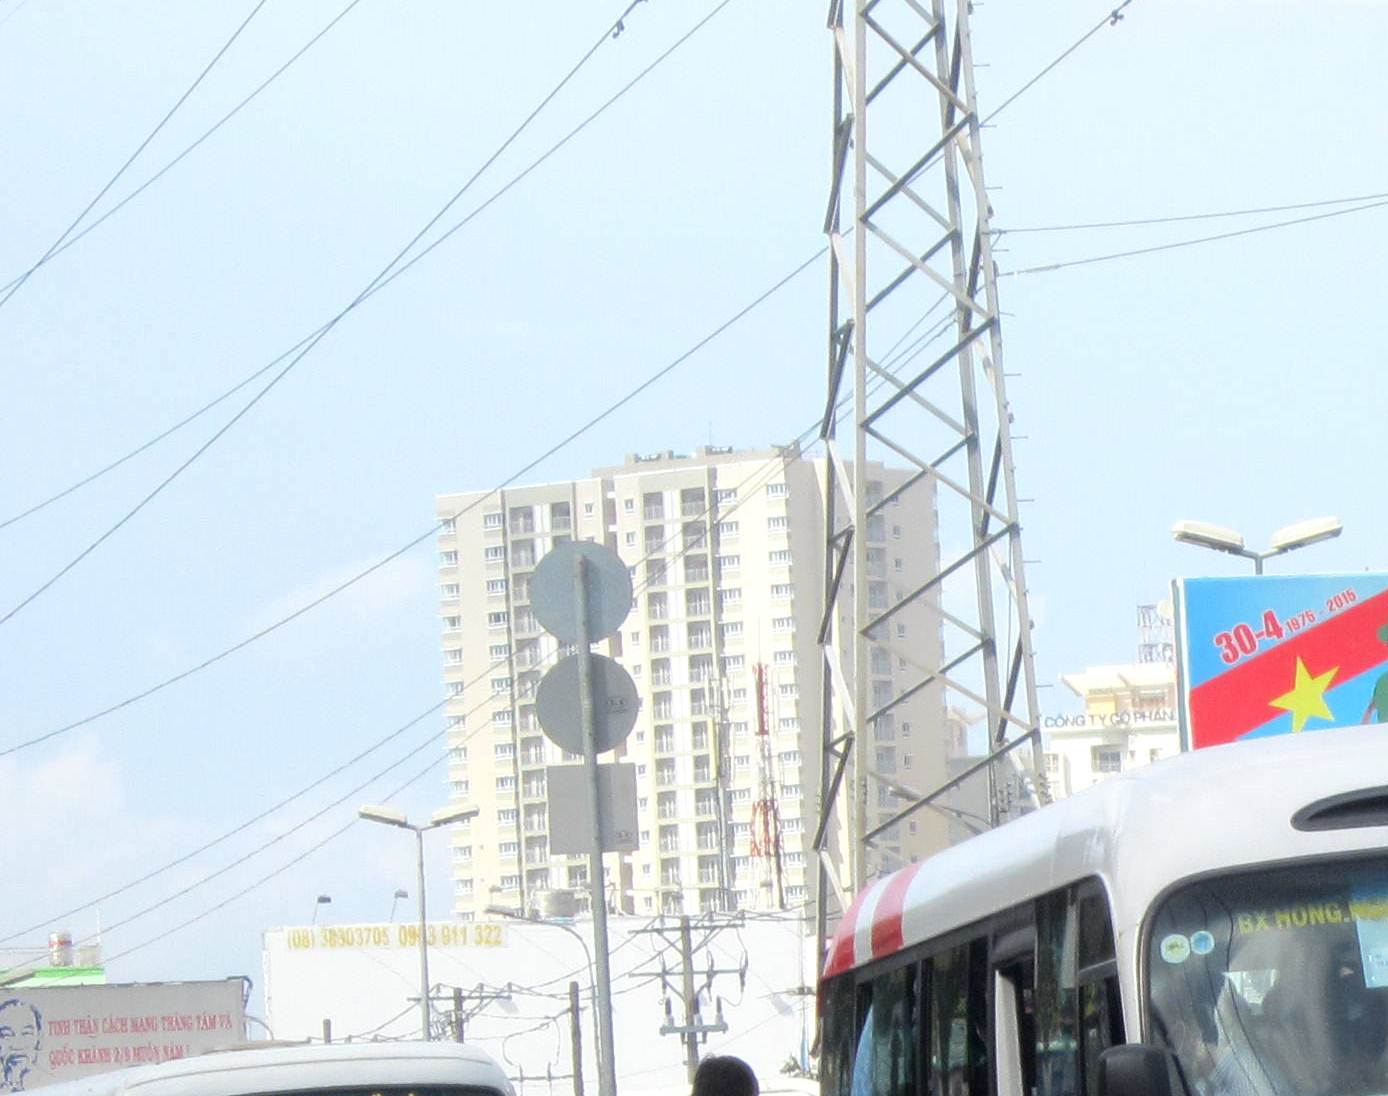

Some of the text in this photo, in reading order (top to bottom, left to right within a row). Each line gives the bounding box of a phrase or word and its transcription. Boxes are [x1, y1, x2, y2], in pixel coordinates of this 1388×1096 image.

[1214, 609, 1285, 665] 30-4
[1285, 609, 1317, 633] 1975
[1326, 588, 1357, 611] 2015
[287, 926, 314, 950] (08)
[474, 923, 503, 946] 322
